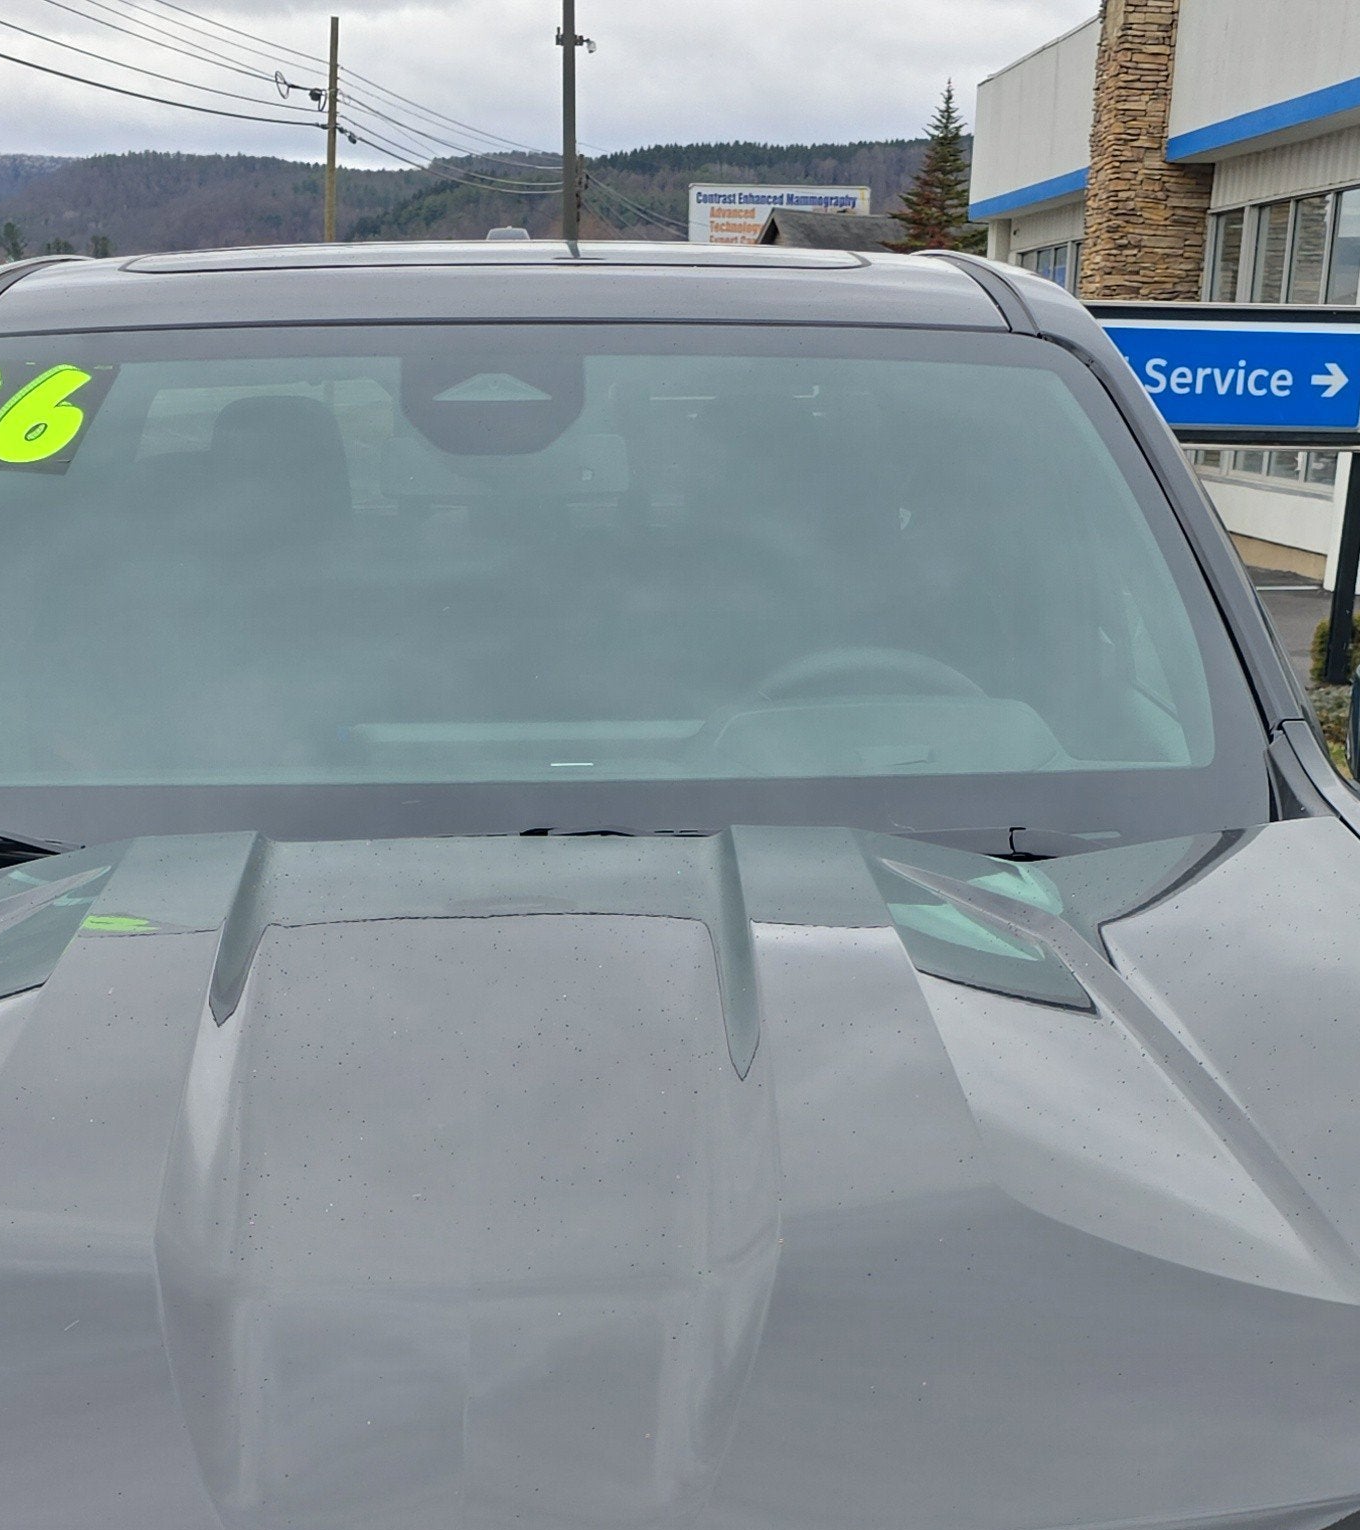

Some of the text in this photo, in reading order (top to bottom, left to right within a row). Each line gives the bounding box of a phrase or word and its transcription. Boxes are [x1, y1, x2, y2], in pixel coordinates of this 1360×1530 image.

[696, 192, 857, 208] Contrast Enhanced Mammography
[709, 207, 756, 218] Advanced
[1144, 358, 1294, 398] Service
